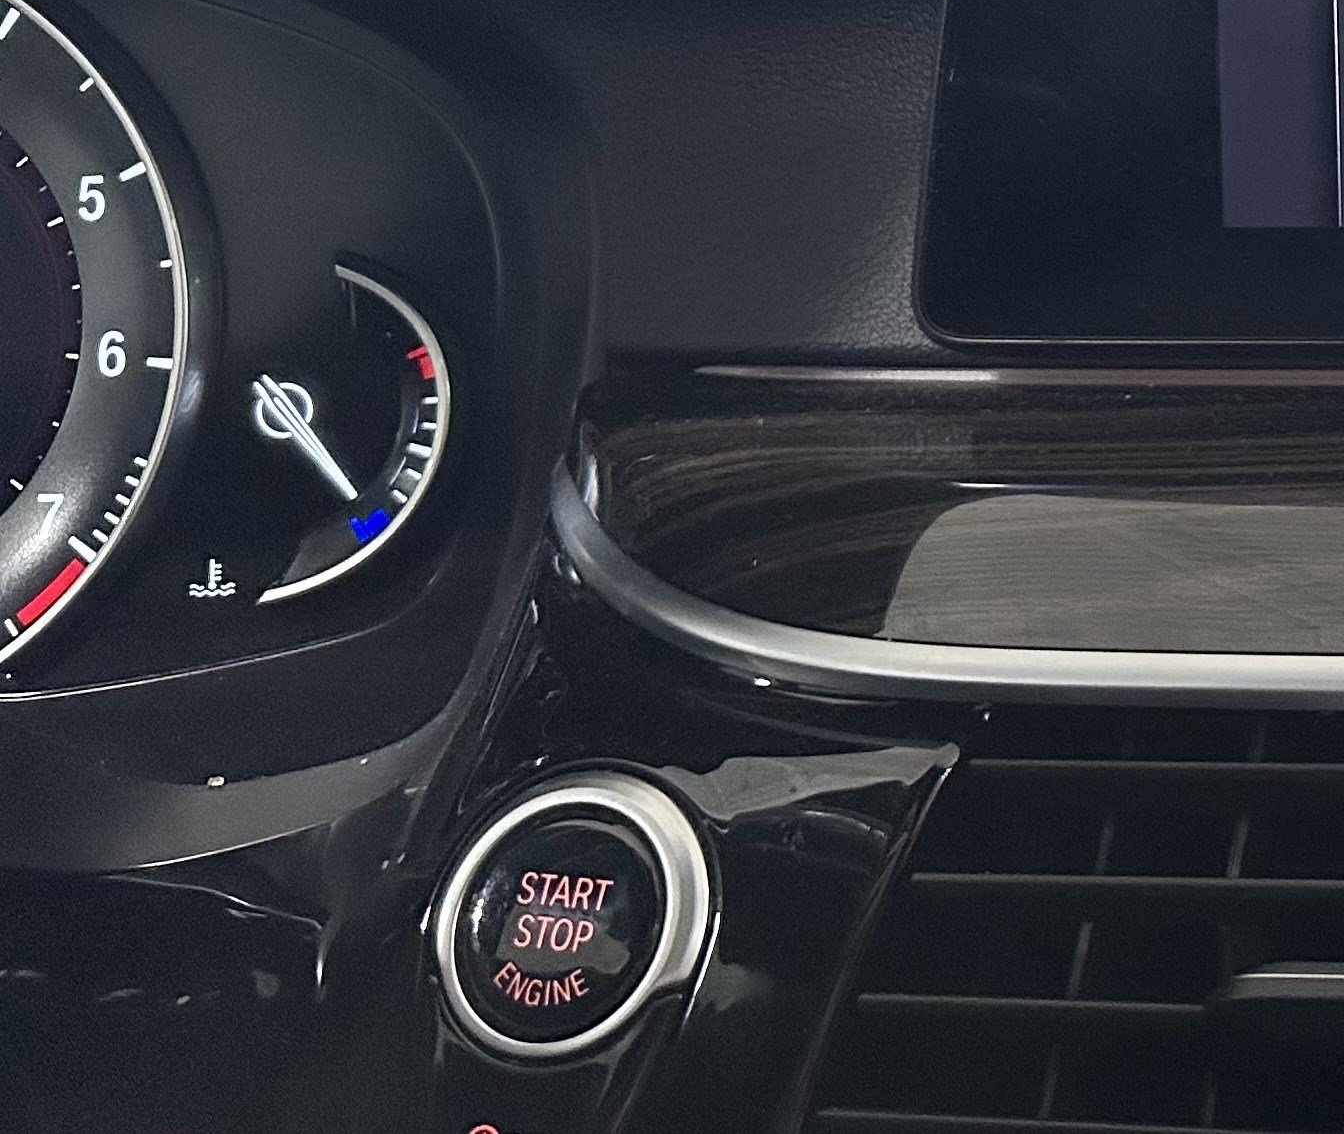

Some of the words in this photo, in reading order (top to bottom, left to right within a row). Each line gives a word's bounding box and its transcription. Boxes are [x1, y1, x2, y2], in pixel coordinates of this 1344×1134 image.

[77, 174, 106, 223] 5
[96, 330, 127, 378] 6
[37, 493, 65, 539] 7
[517, 871, 615, 912] START
[513, 914, 595, 953] STOP
[493, 961, 588, 1007] ENGINE
